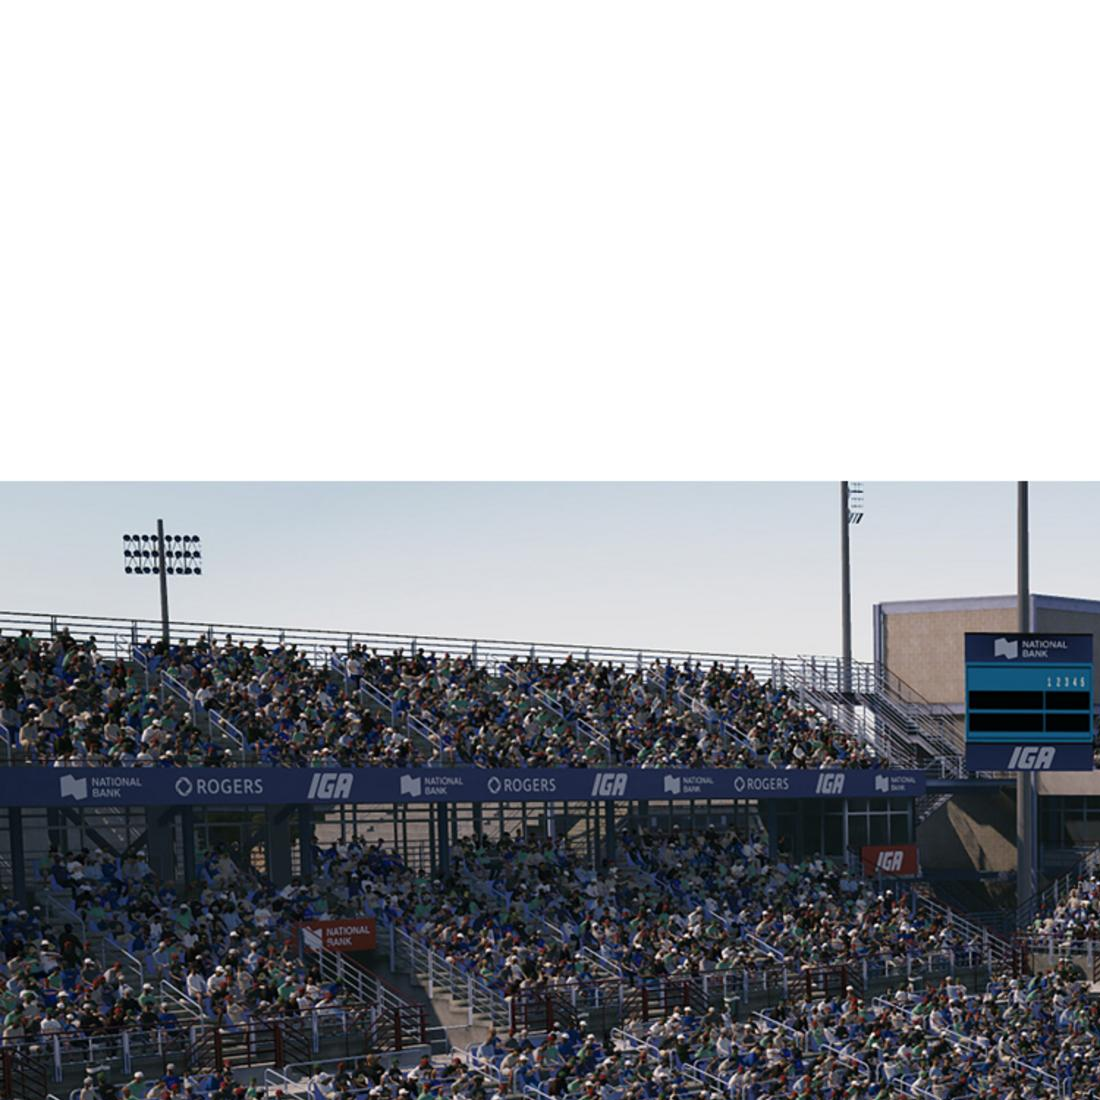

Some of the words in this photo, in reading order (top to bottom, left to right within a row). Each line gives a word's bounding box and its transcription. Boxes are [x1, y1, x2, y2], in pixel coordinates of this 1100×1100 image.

[1022, 640, 1068, 650] NATIONAL
[1022, 649, 1049, 659] BANK
[1007, 746, 1057, 770] IGA
[91, 777, 142, 788] NATIONAL
[424, 776, 464, 787] NATIONAL
[504, 778, 557, 793] ROGERS
[591, 773, 628, 797] IGA
[683, 775, 713, 785] NATIONAL
[747, 777, 789, 791] ROGERS
[816, 773, 845, 795] IGA
[197, 779, 263, 795] ROGERS
[307, 773, 354, 800] IGA
[424, 786, 447, 796] BANK
[91, 788, 122, 799] BANK
[877, 850, 904, 872] IGA
[326, 926, 371, 937] NATIONAL
[326, 936, 353, 946] BANK
